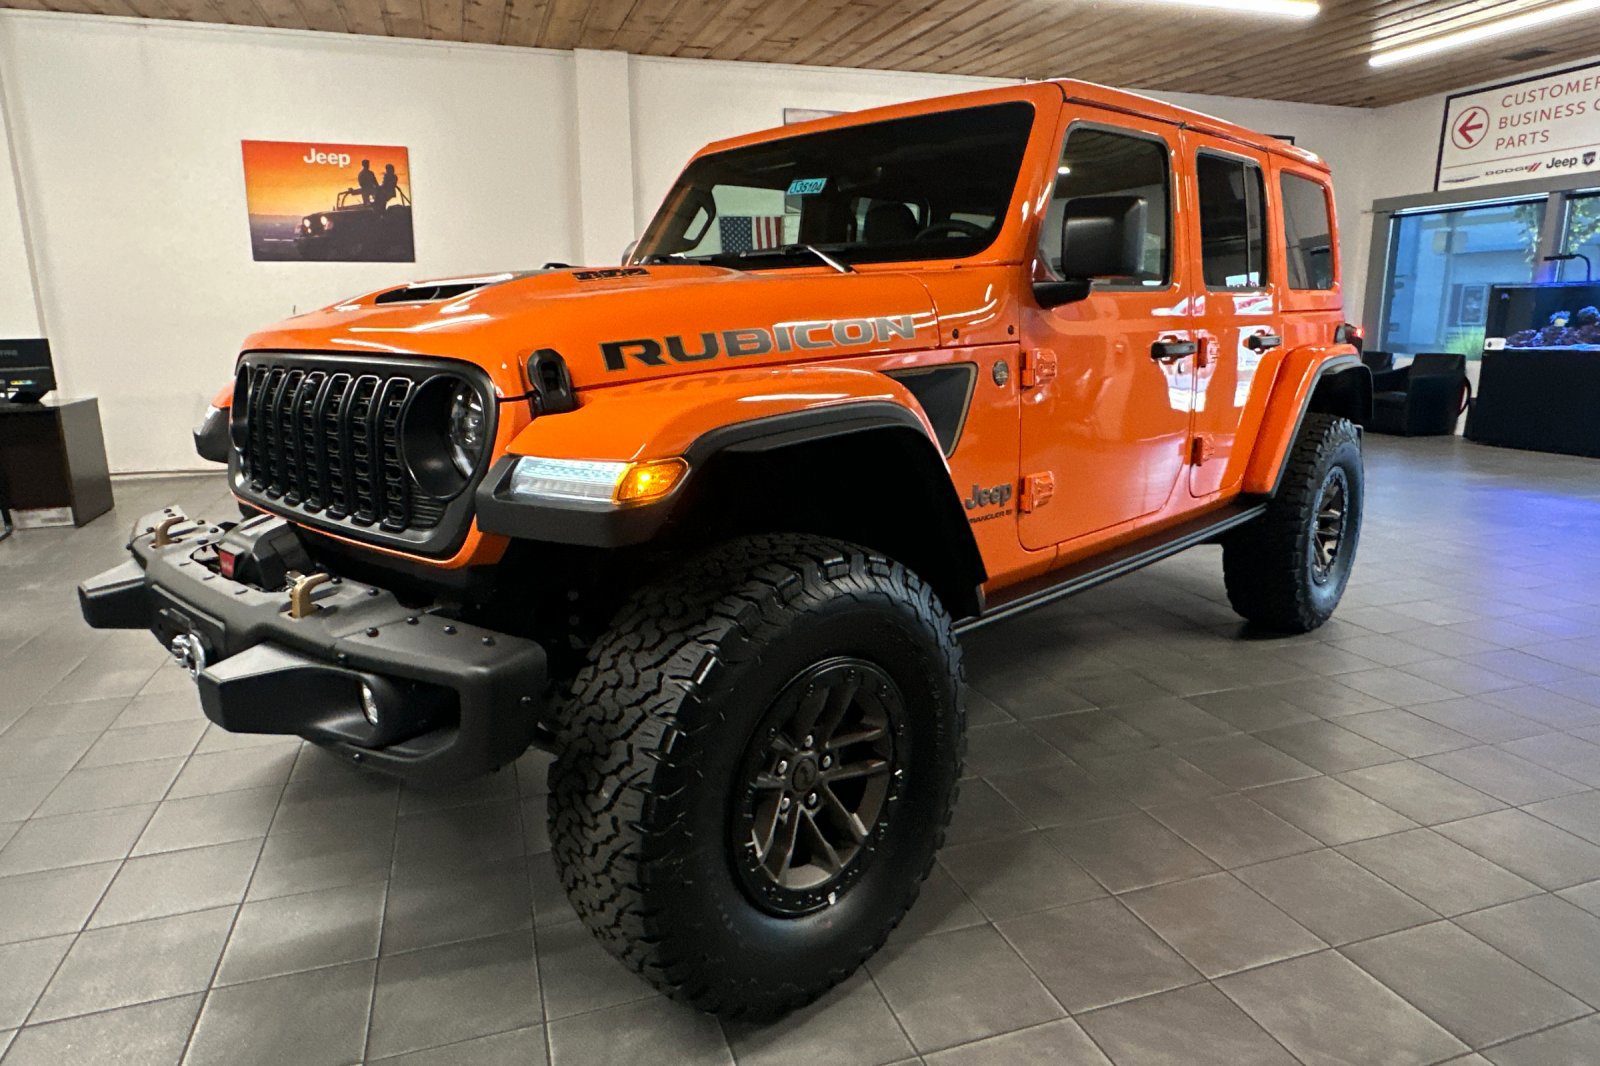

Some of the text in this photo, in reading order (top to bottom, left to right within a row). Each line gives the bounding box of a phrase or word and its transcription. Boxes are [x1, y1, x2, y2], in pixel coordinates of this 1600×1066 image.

[1499, 101, 1586, 130] BUSINESS
[1495, 130, 1550, 150] PARTS
[303, 148, 351, 168] Jeep
[1546, 156, 1578, 169] Jeep
[600, 316, 915, 372] RUBICON
[965, 483, 1012, 509] Jeep
